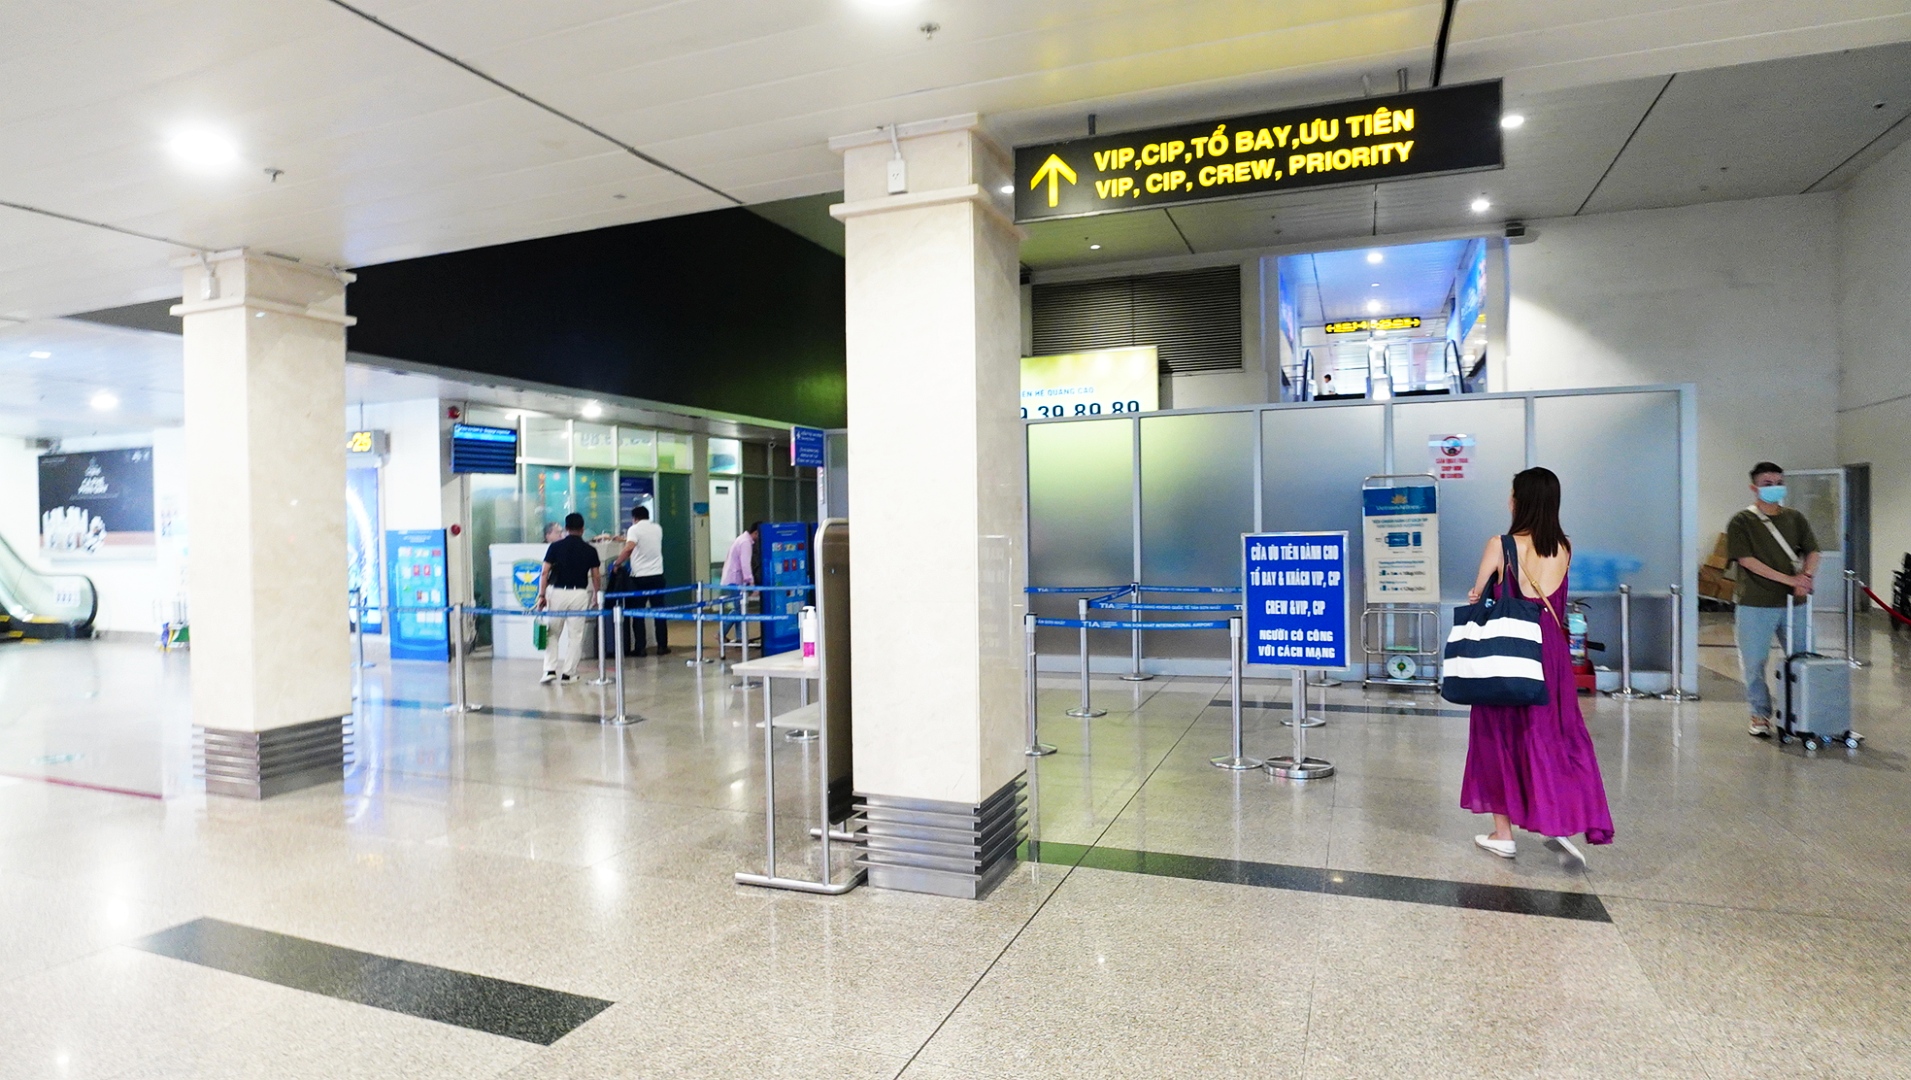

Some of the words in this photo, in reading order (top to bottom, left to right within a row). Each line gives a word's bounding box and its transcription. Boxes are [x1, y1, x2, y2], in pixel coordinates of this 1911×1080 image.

[1346, 107, 1415, 138] TIÊN
[1095, 176, 1140, 199] VIP,
[1146, 169, 1193, 195] CIP,
[1199, 158, 1283, 188] CREW,
[1289, 141, 1414, 176] PRIORITY
[1323, 545, 1339, 560] CHO
[1261, 571, 1277, 586] BAY
[1278, 571, 1285, 586] &
[1285, 568, 1311, 586] KHÁCH
[1328, 571, 1341, 586] CIP
[1265, 600, 1288, 615] CREW
[1312, 600, 1326, 615] CIP
[1259, 628, 1288, 641] NGƯỜI
[1290, 629, 1304, 641] CÓ
[1306, 629, 1333, 642] CÔNG
[1258, 644, 1275, 657] VỚI
[1277, 645, 1303, 657] CÁCH
[1305, 647, 1336, 660] MẠNG
